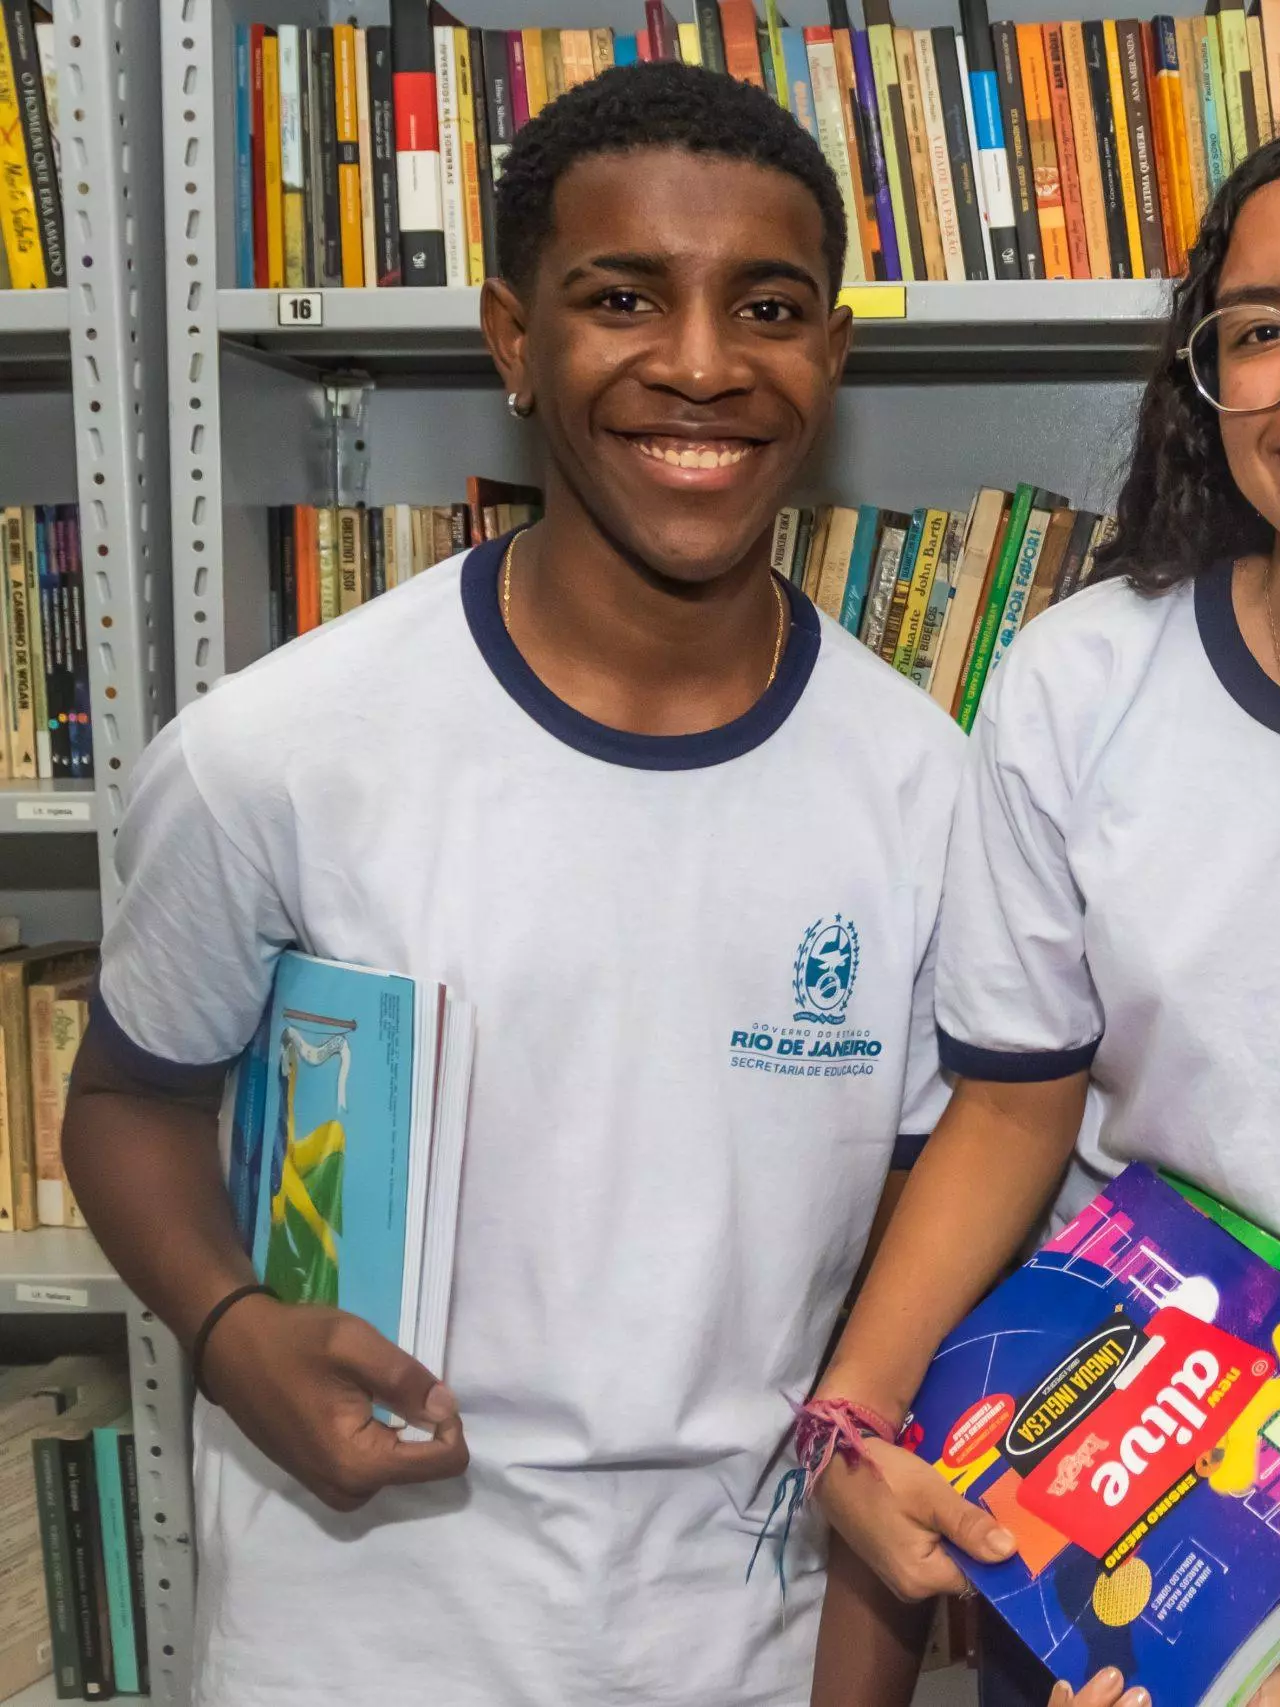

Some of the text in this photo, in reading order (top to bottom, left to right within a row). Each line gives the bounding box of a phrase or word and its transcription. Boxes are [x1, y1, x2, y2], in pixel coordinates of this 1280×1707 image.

[1126, 33, 1141, 102] ANA MIRANDA
[1136, 125, 1150, 173] QUIMERA
[290, 298, 312, 320] 16
[341, 517, 355, 564] LOUZEIRO
[913, 516, 944, 597] John Barth
[1007, 591, 1026, 622] POR
[13, 580, 29, 710] A CAMINHO DE WIGAN
[730, 1029, 882, 1058] RIO DE JANEIRO
[752, 1022, 871, 1039] GOVERNO DO ESTADO
[731, 1056, 874, 1077] SECRETARIA DE EDUCAÇÃO
[1016, 1338, 1125, 1444] LÍNGUA INGLESA
[1206, 1366, 1241, 1409] new
[1090, 1349, 1220, 1507] alive
[1104, 1473, 1198, 1569] ENSINO MÉDIO
[1168, 1551, 1197, 1586] RONALDO
[1178, 1558, 1205, 1591] MARCOS
